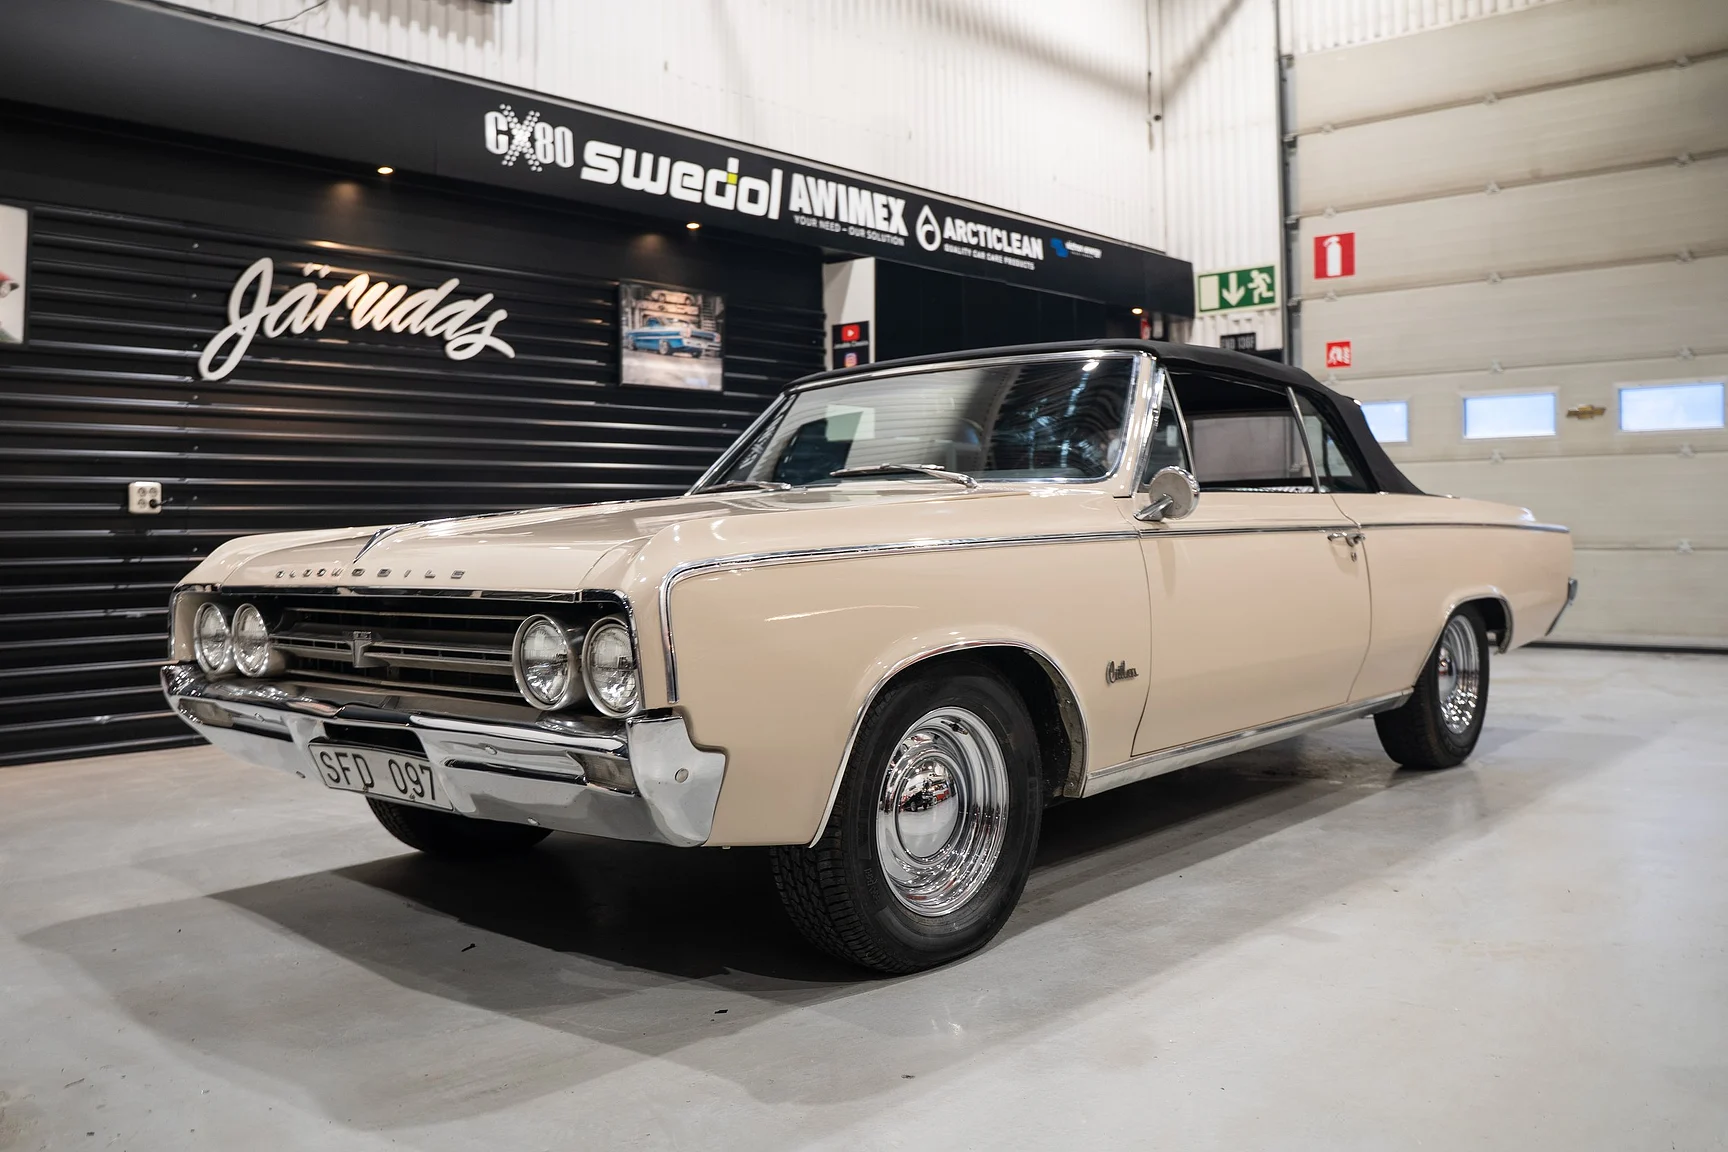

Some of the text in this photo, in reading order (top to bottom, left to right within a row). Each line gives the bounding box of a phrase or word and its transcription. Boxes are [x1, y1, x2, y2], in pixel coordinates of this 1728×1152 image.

[484, 103, 575, 172] CX80
[580, 140, 783, 220] swedol
[788, 172, 909, 237] AWIMEX
[793, 214, 818, 228] YOUR
[819, 220, 841, 233] NEED
[848, 225, 866, 239] OUR
[866, 229, 905, 247] SOLUTION
[942, 216, 1044, 260] ARCTICLEAN
[943, 243, 1036, 271] QUALITY CAR CARE PRODUCTS
[319, 751, 436, 801] SFD 097
